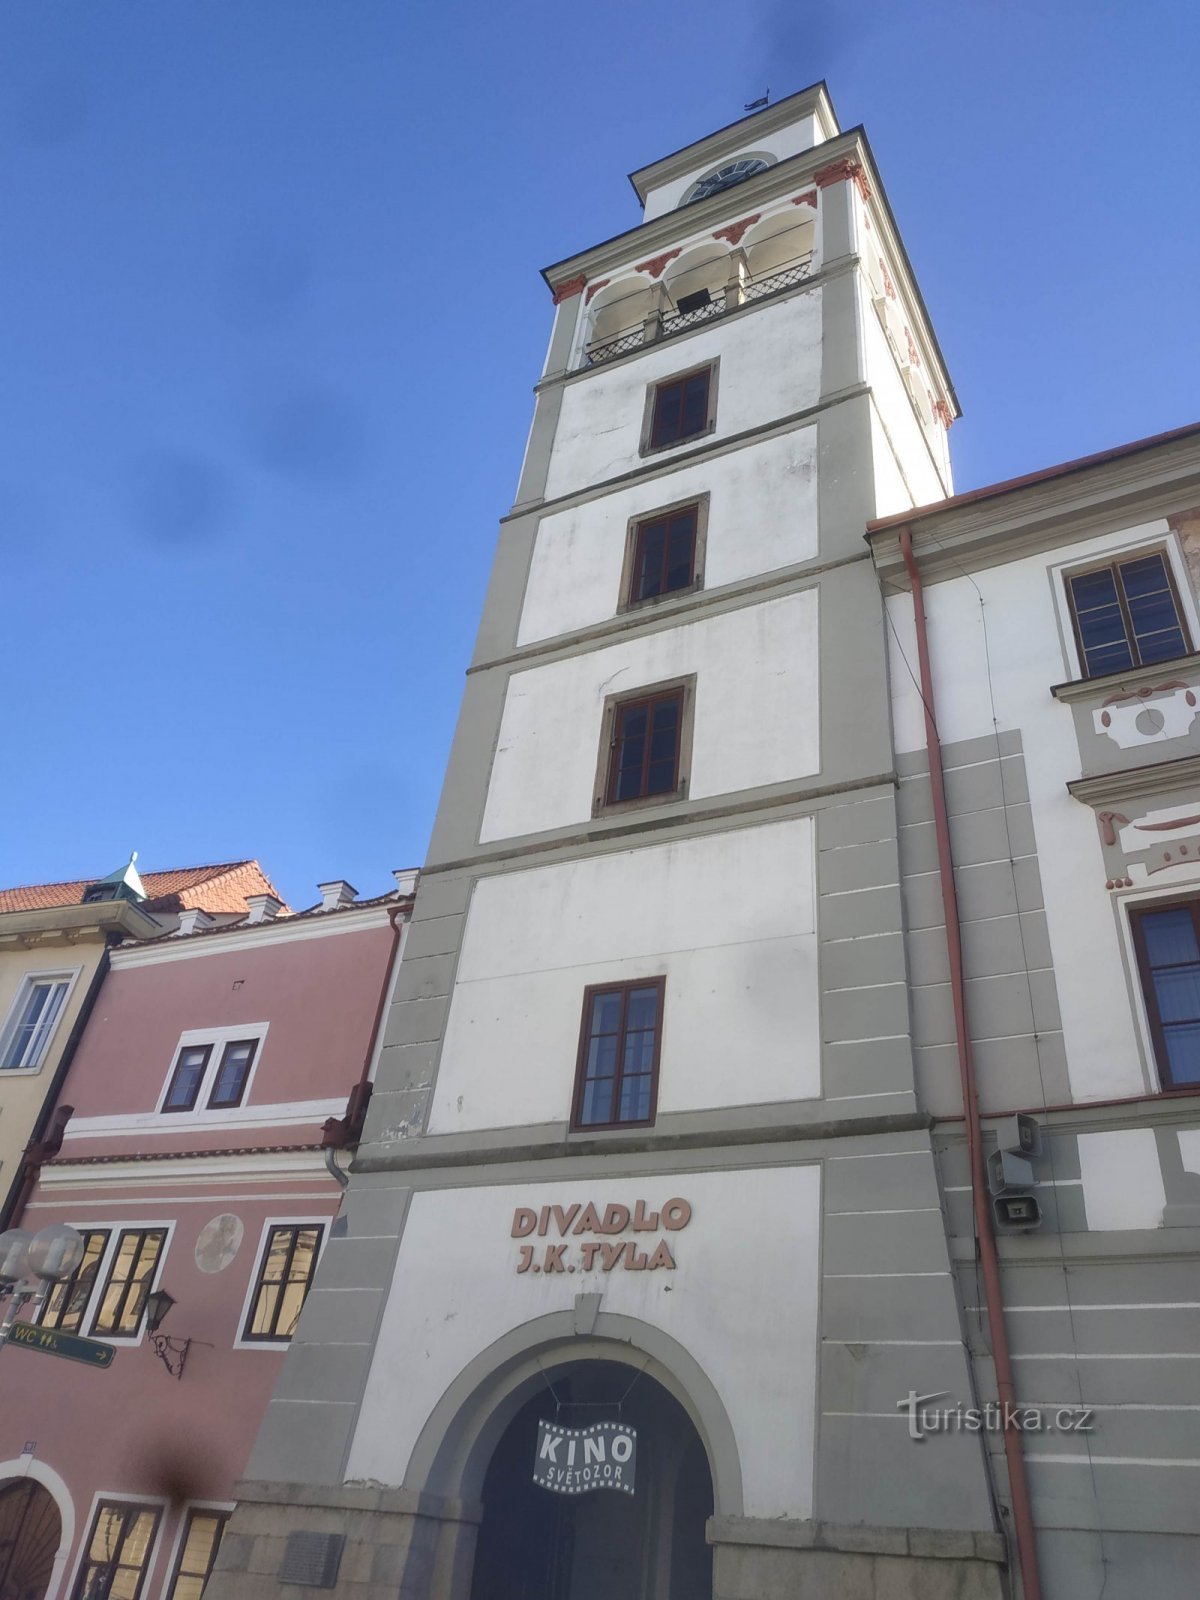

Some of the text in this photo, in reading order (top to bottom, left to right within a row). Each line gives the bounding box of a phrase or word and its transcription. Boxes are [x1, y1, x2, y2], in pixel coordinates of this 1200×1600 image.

[511, 1197, 692, 1238] DIVADLO
[15, 1326, 36, 1343] WC
[540, 1433, 633, 1466] KINO
[547, 1464, 622, 1485] SVĚTOZOR
